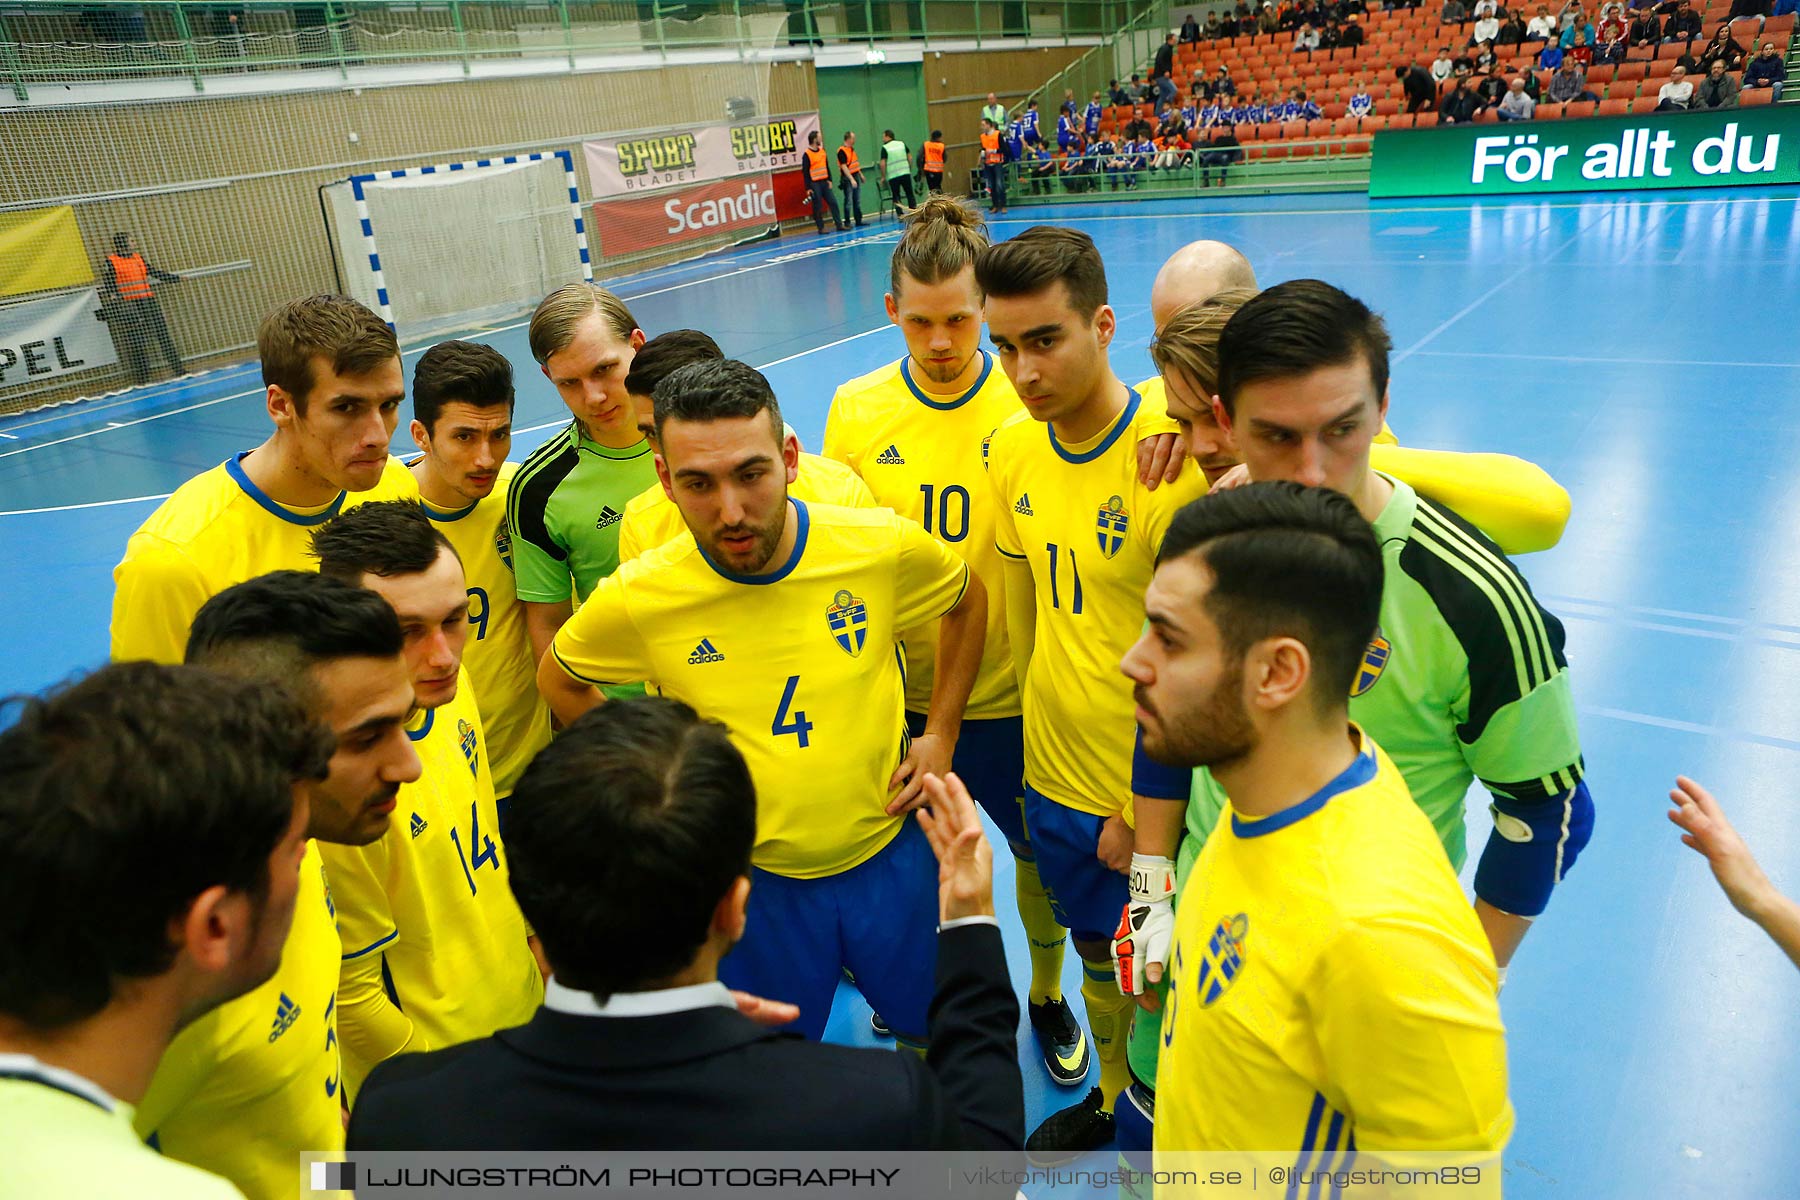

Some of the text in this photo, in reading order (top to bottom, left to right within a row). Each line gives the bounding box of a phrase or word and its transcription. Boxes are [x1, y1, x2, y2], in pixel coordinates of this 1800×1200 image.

[616, 133, 697, 178] SPORT
[730, 120, 797, 160] SPORT
[738, 153, 798, 172] BLADET
[1472, 122, 1780, 183] För allt du
[627, 170, 697, 189] BLADET
[665, 183, 776, 235] Scandic
[876, 457, 905, 465] adidas
[596, 513, 623, 530] adidas
[920, 485, 970, 543] 10
[1047, 543, 1082, 614] 11
[466, 587, 490, 640] 9
[688, 654, 726, 665] adidas
[772, 675, 813, 748] 4
[450, 801, 500, 897] 14
